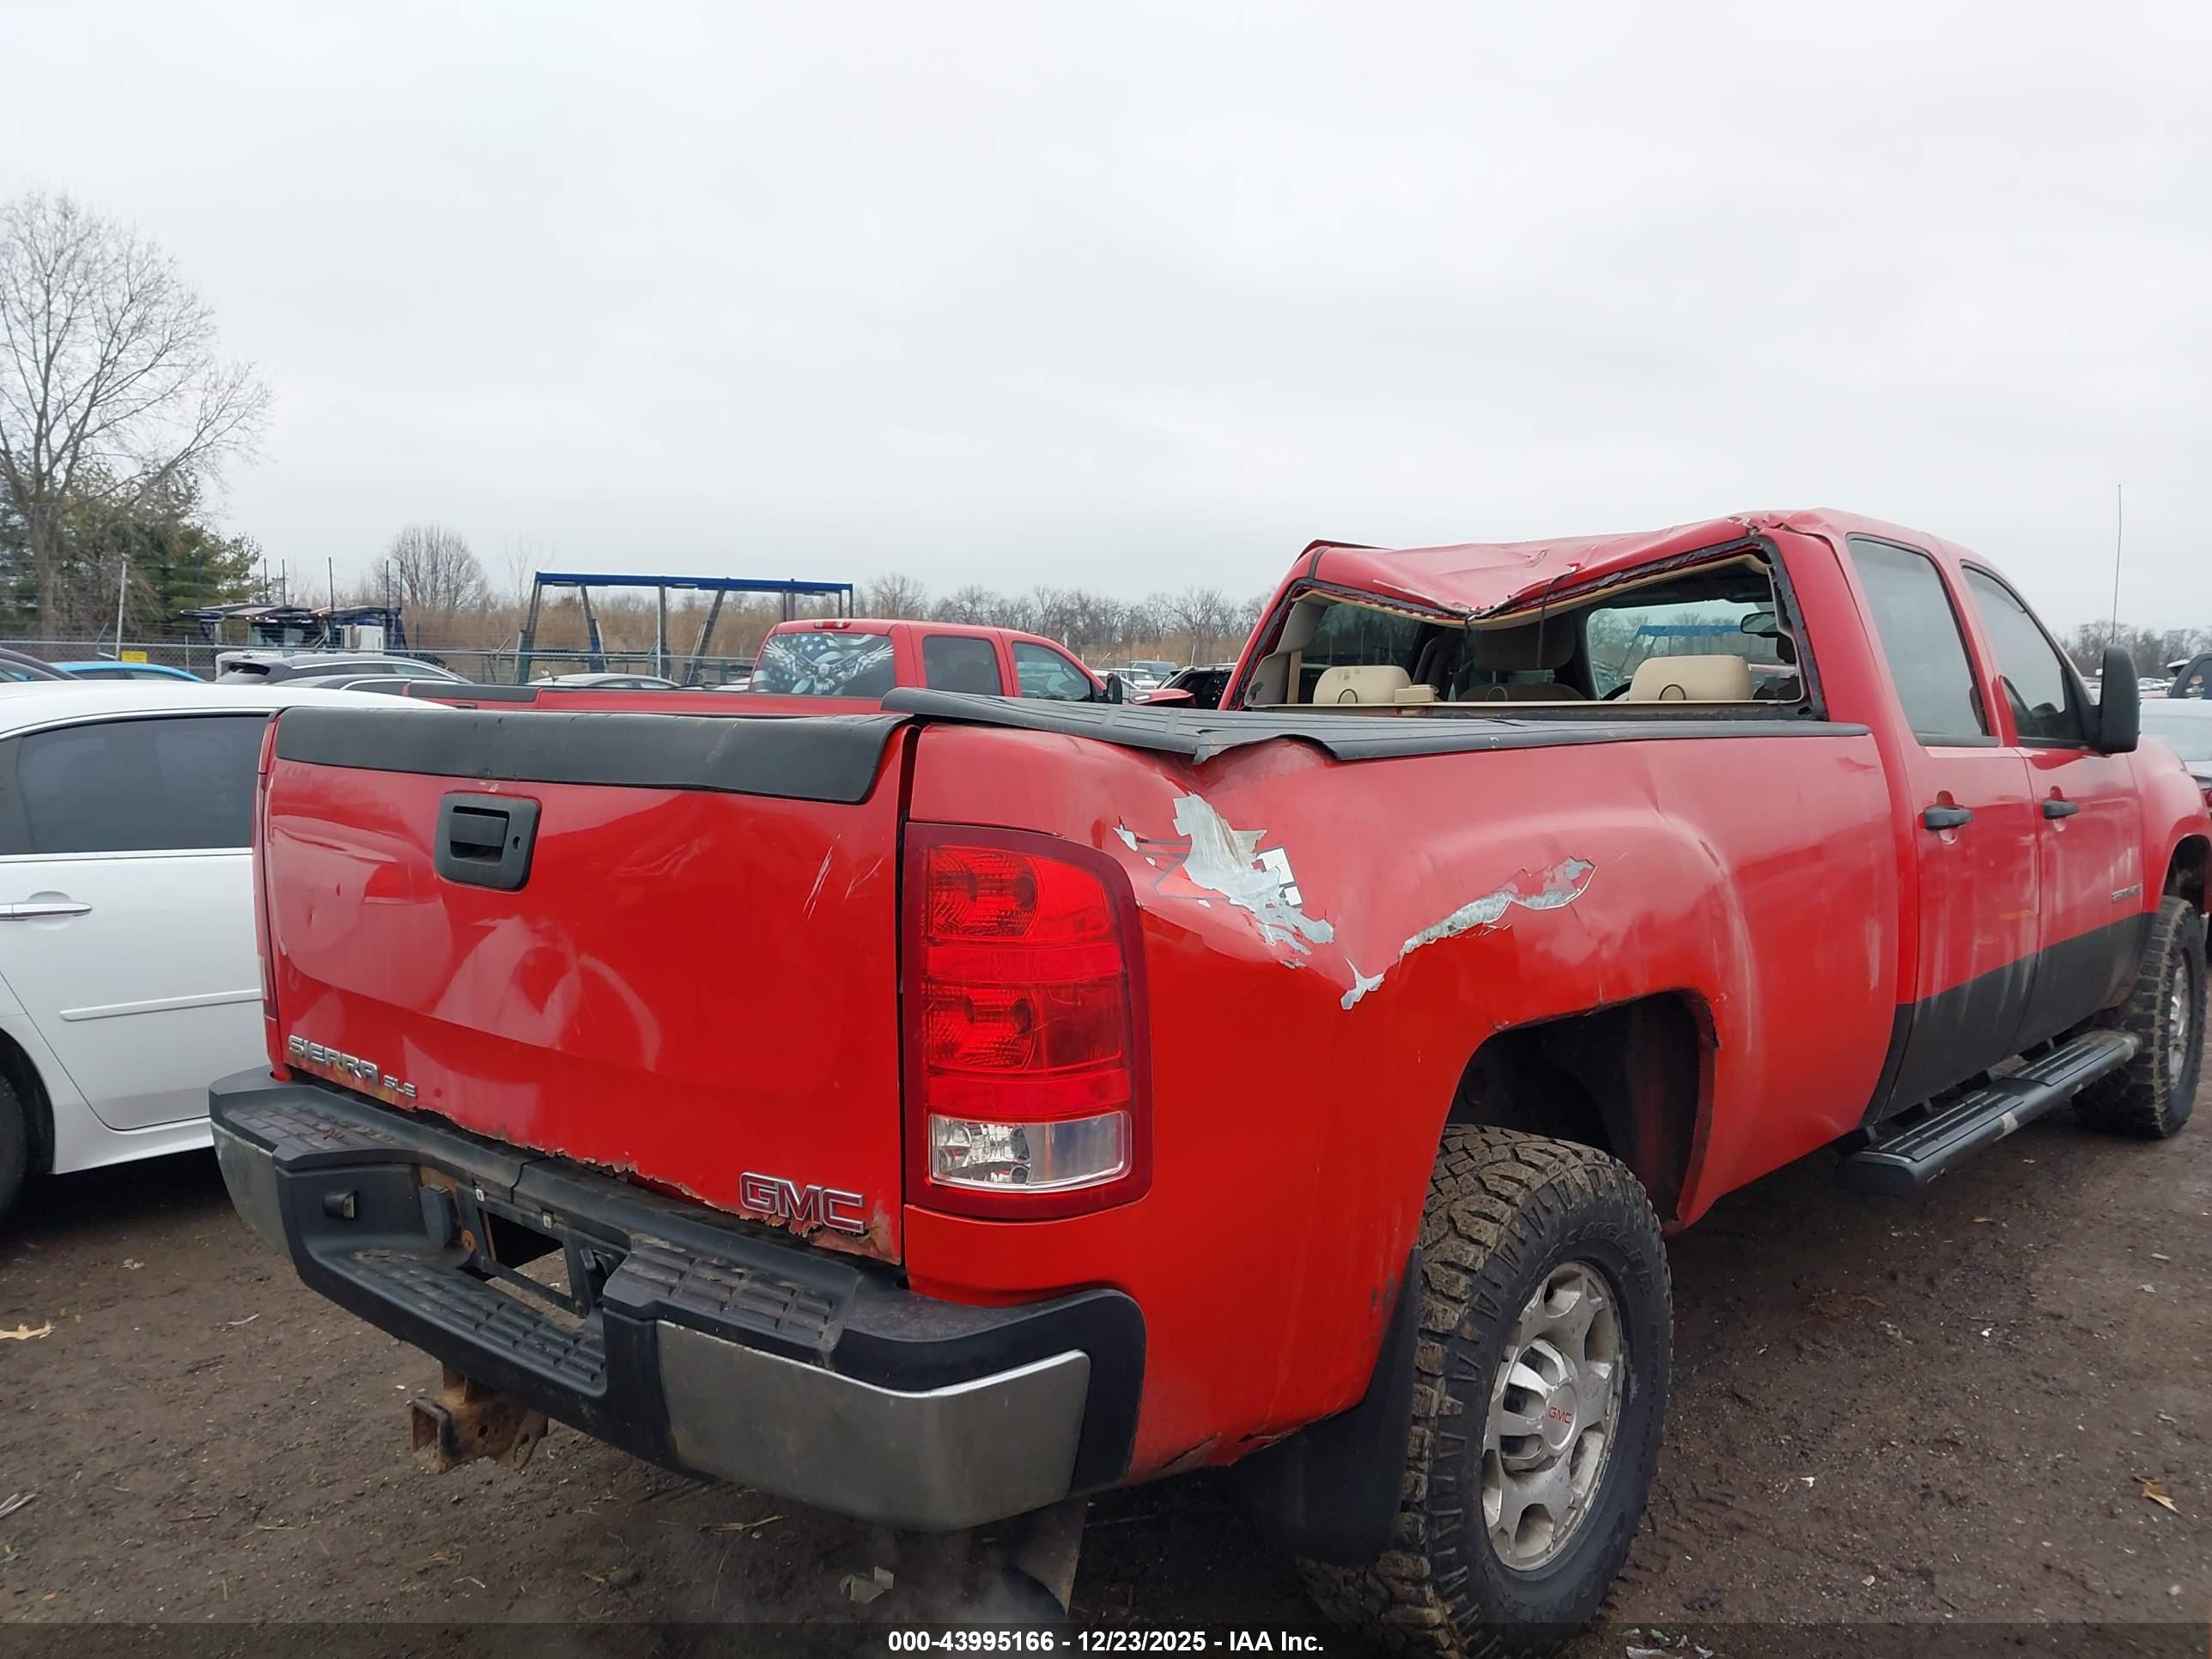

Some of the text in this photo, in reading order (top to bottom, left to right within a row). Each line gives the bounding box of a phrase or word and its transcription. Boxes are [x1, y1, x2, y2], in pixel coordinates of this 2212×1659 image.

[288, 1035, 416, 1098] SIERRA SLE
[739, 1171, 865, 1234] GMC
[1549, 1406, 1572, 1425] GMC
